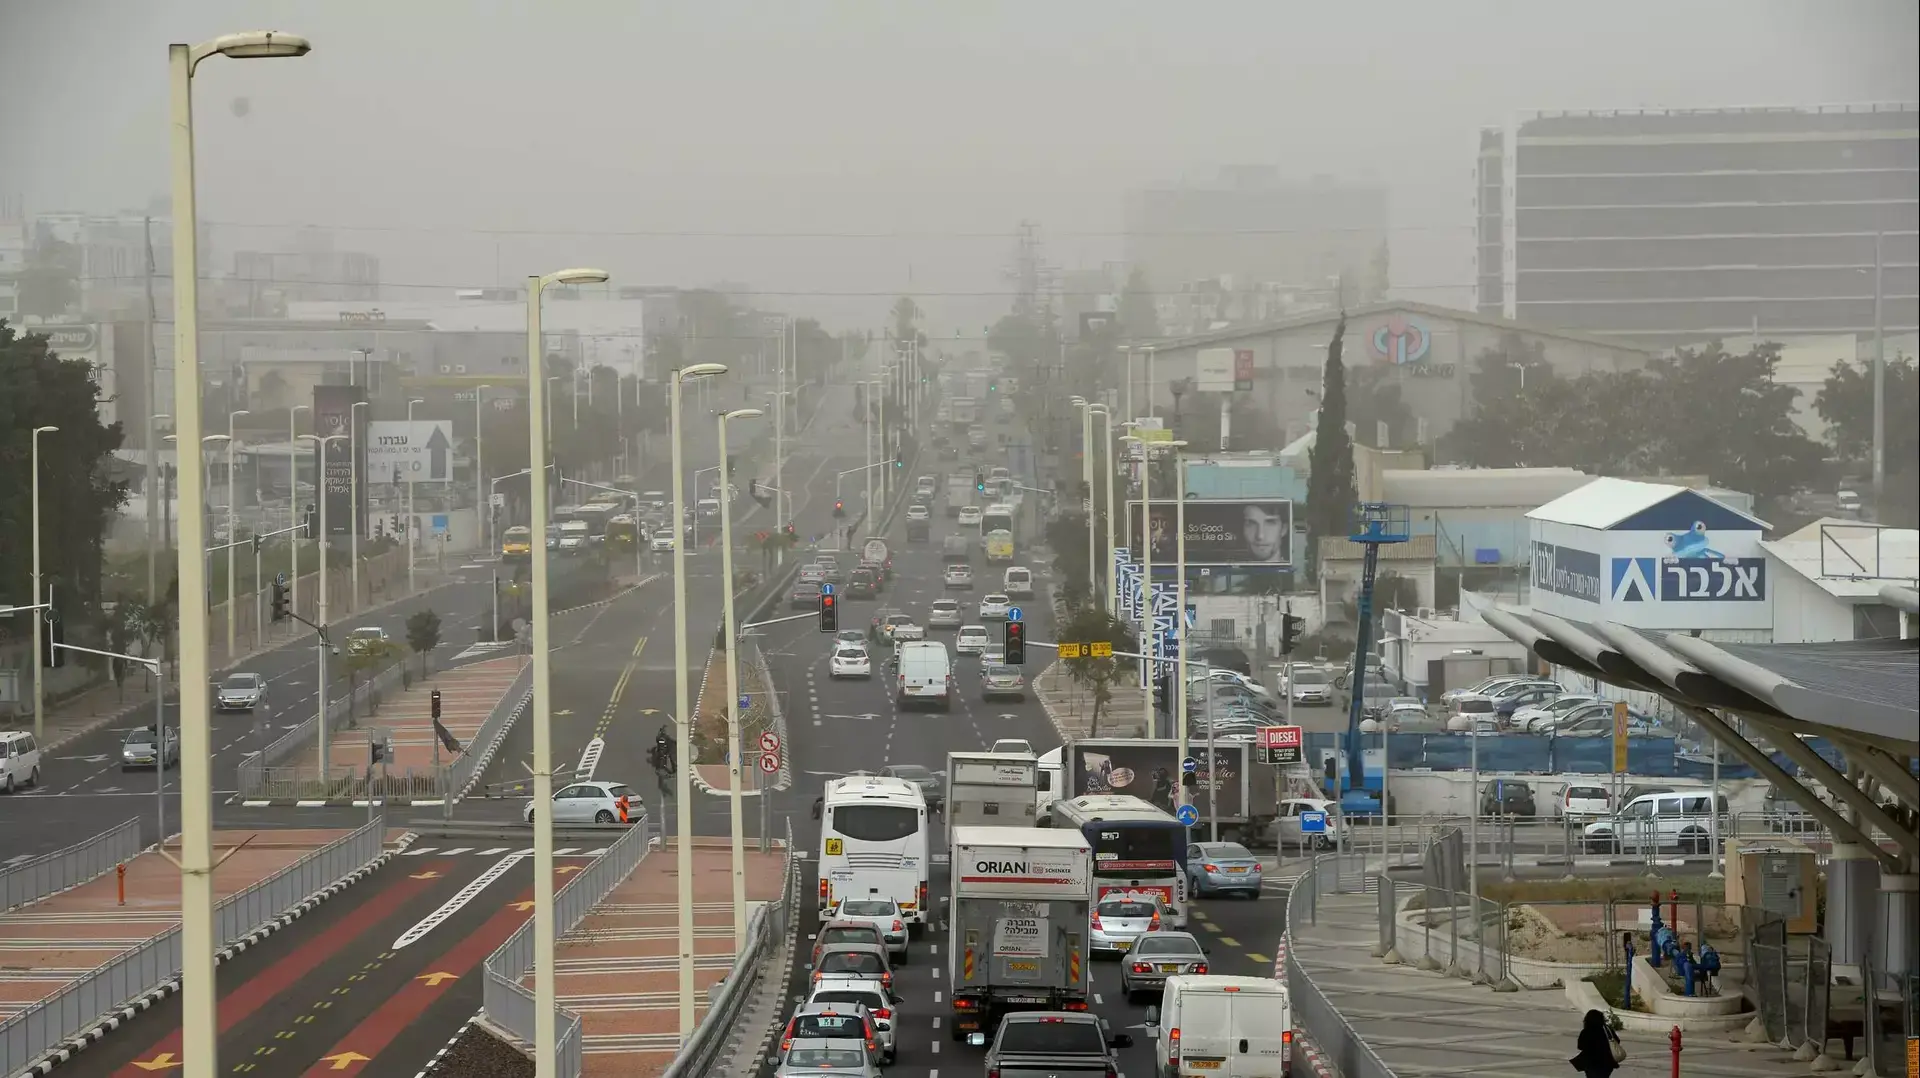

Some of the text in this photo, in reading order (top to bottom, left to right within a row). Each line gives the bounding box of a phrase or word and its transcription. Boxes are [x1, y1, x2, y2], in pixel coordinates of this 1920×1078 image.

[378, 436, 408, 445] עברנו
[1188, 524, 1223, 532] So Good
[1202, 532, 1216, 541] Like
[1539, 546, 1553, 587] אלבר
[1667, 561, 1758, 597] אלבר
[1082, 645, 1088, 655] 6
[1270, 731, 1298, 743] DIESEL
[976, 861, 1026, 874] ORIAN
[1007, 919, 1036, 927] בחברה
[1004, 927, 1039, 935] מובילה?
